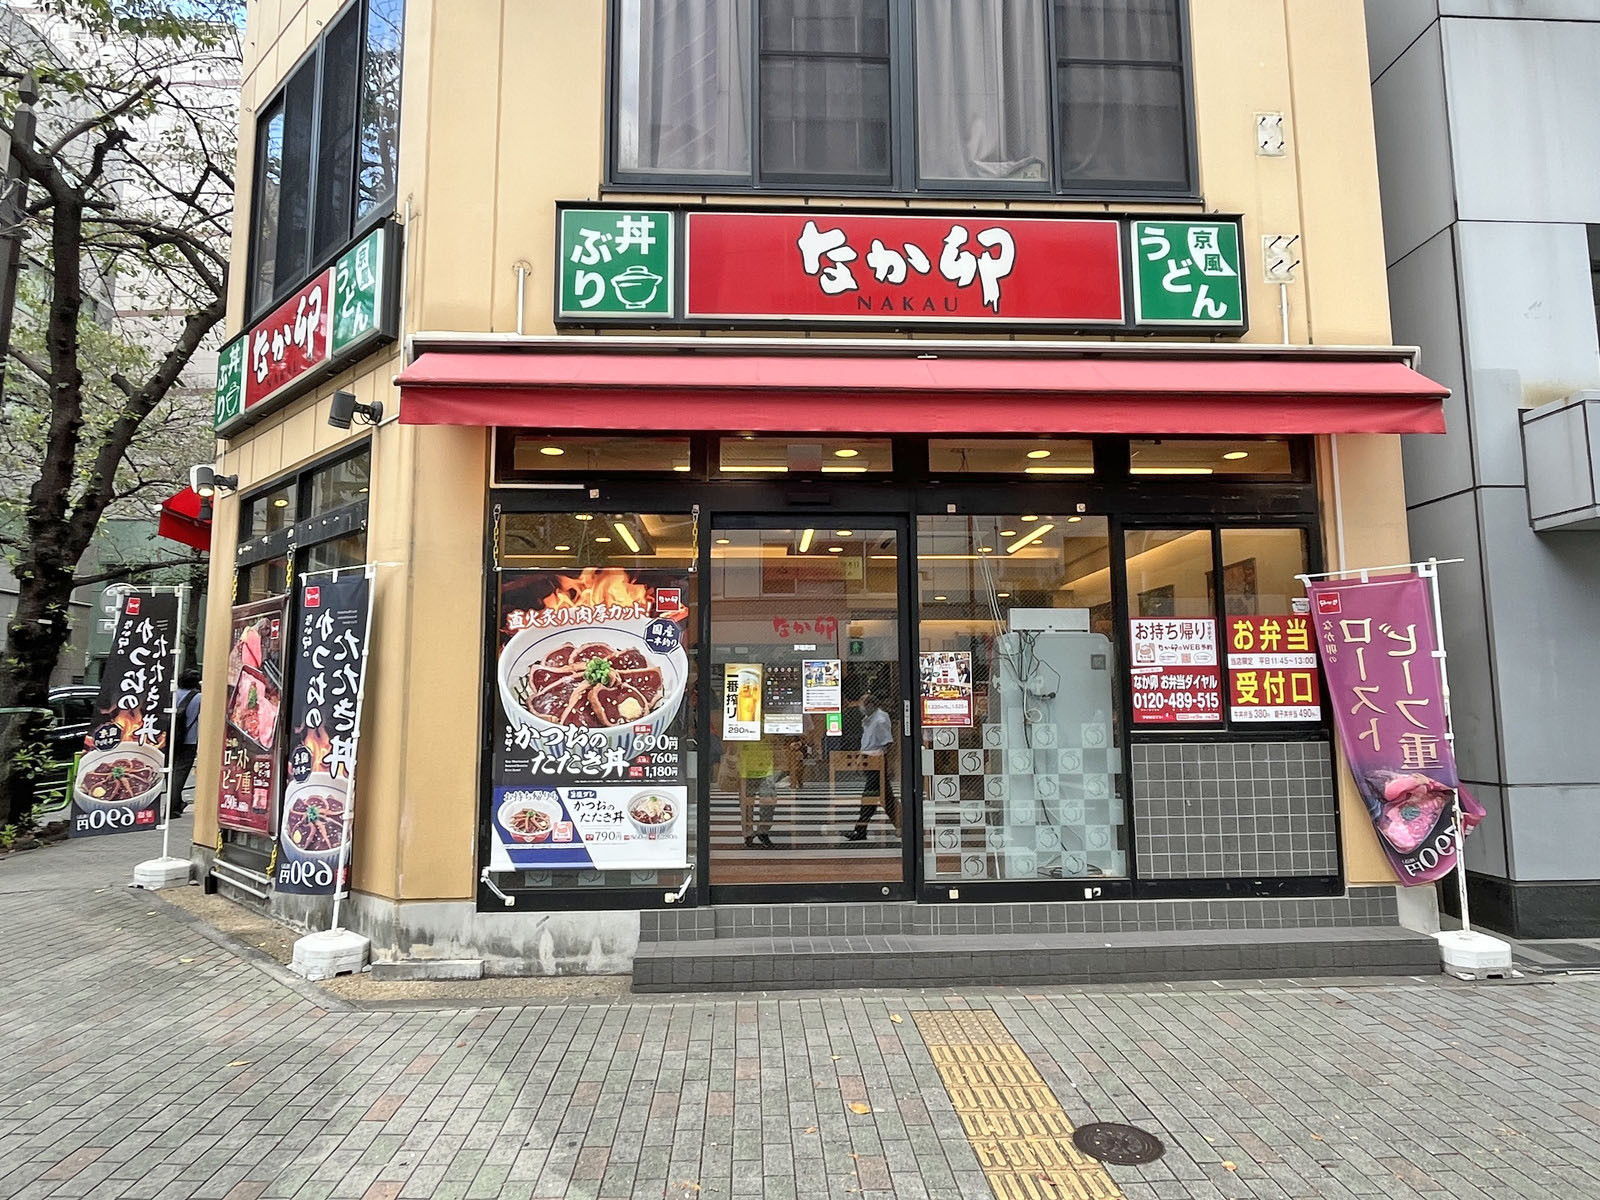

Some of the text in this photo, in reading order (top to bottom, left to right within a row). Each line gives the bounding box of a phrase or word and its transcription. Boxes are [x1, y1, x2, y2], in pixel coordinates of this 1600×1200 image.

[1192, 228, 1222, 273] 京風
[797, 220, 1015, 314] なか卯
[1140, 227, 1228, 319] うどん
[858, 296, 959, 313] NAKAU
[253, 285, 322, 384] なか卯
[652, 624, 674, 637] 国産
[772, 616, 838, 640] なか卯
[1135, 622, 1205, 640] お持ち帰り
[1233, 618, 1308, 651] お弁当
[646, 637, 677, 647] 一本釣り
[1134, 674, 1217, 690] なか卯 お弁当ダイヤル
[1236, 671, 1313, 704] 受付口
[1133, 692, 1219, 709] 0120-489-515
[514, 724, 608, 750] かつおの
[224, 748, 249, 769] ロースト
[531, 747, 630, 778] たたき丼
[650, 753, 678, 764] 760円
[222, 769, 251, 794] ビーフ重
[644, 766, 678, 778] 1,180円
[573, 800, 615, 811] かつおの
[580, 812, 624, 823] たたき丼
